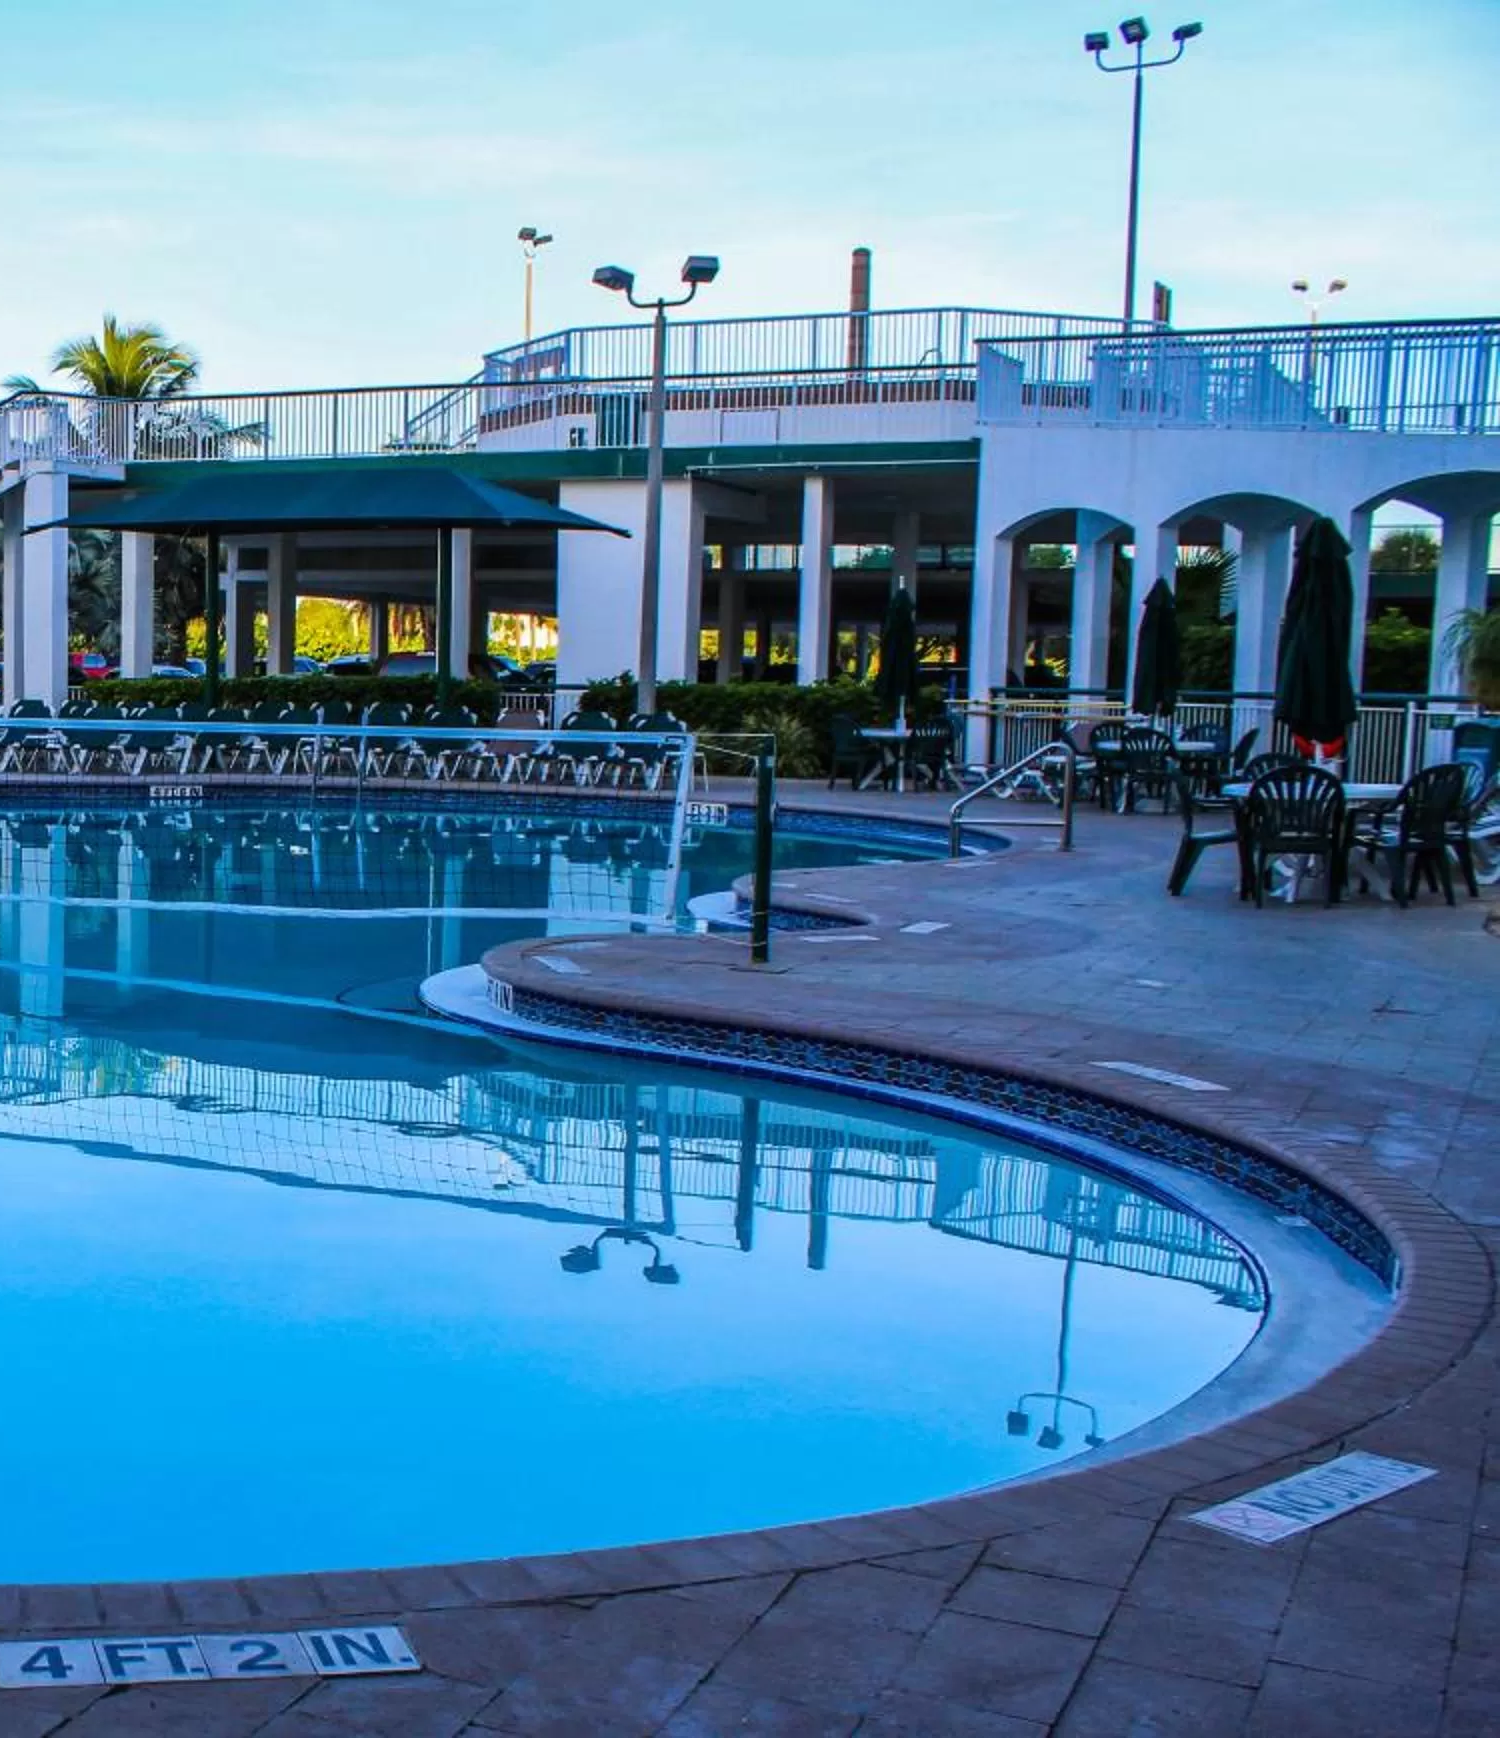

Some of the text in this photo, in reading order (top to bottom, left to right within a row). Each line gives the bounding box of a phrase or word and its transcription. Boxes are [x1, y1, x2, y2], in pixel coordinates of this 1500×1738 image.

[1246, 1489, 1336, 1523] NO
[20, 1632, 413, 1679] 4 FT. 2 IN.
